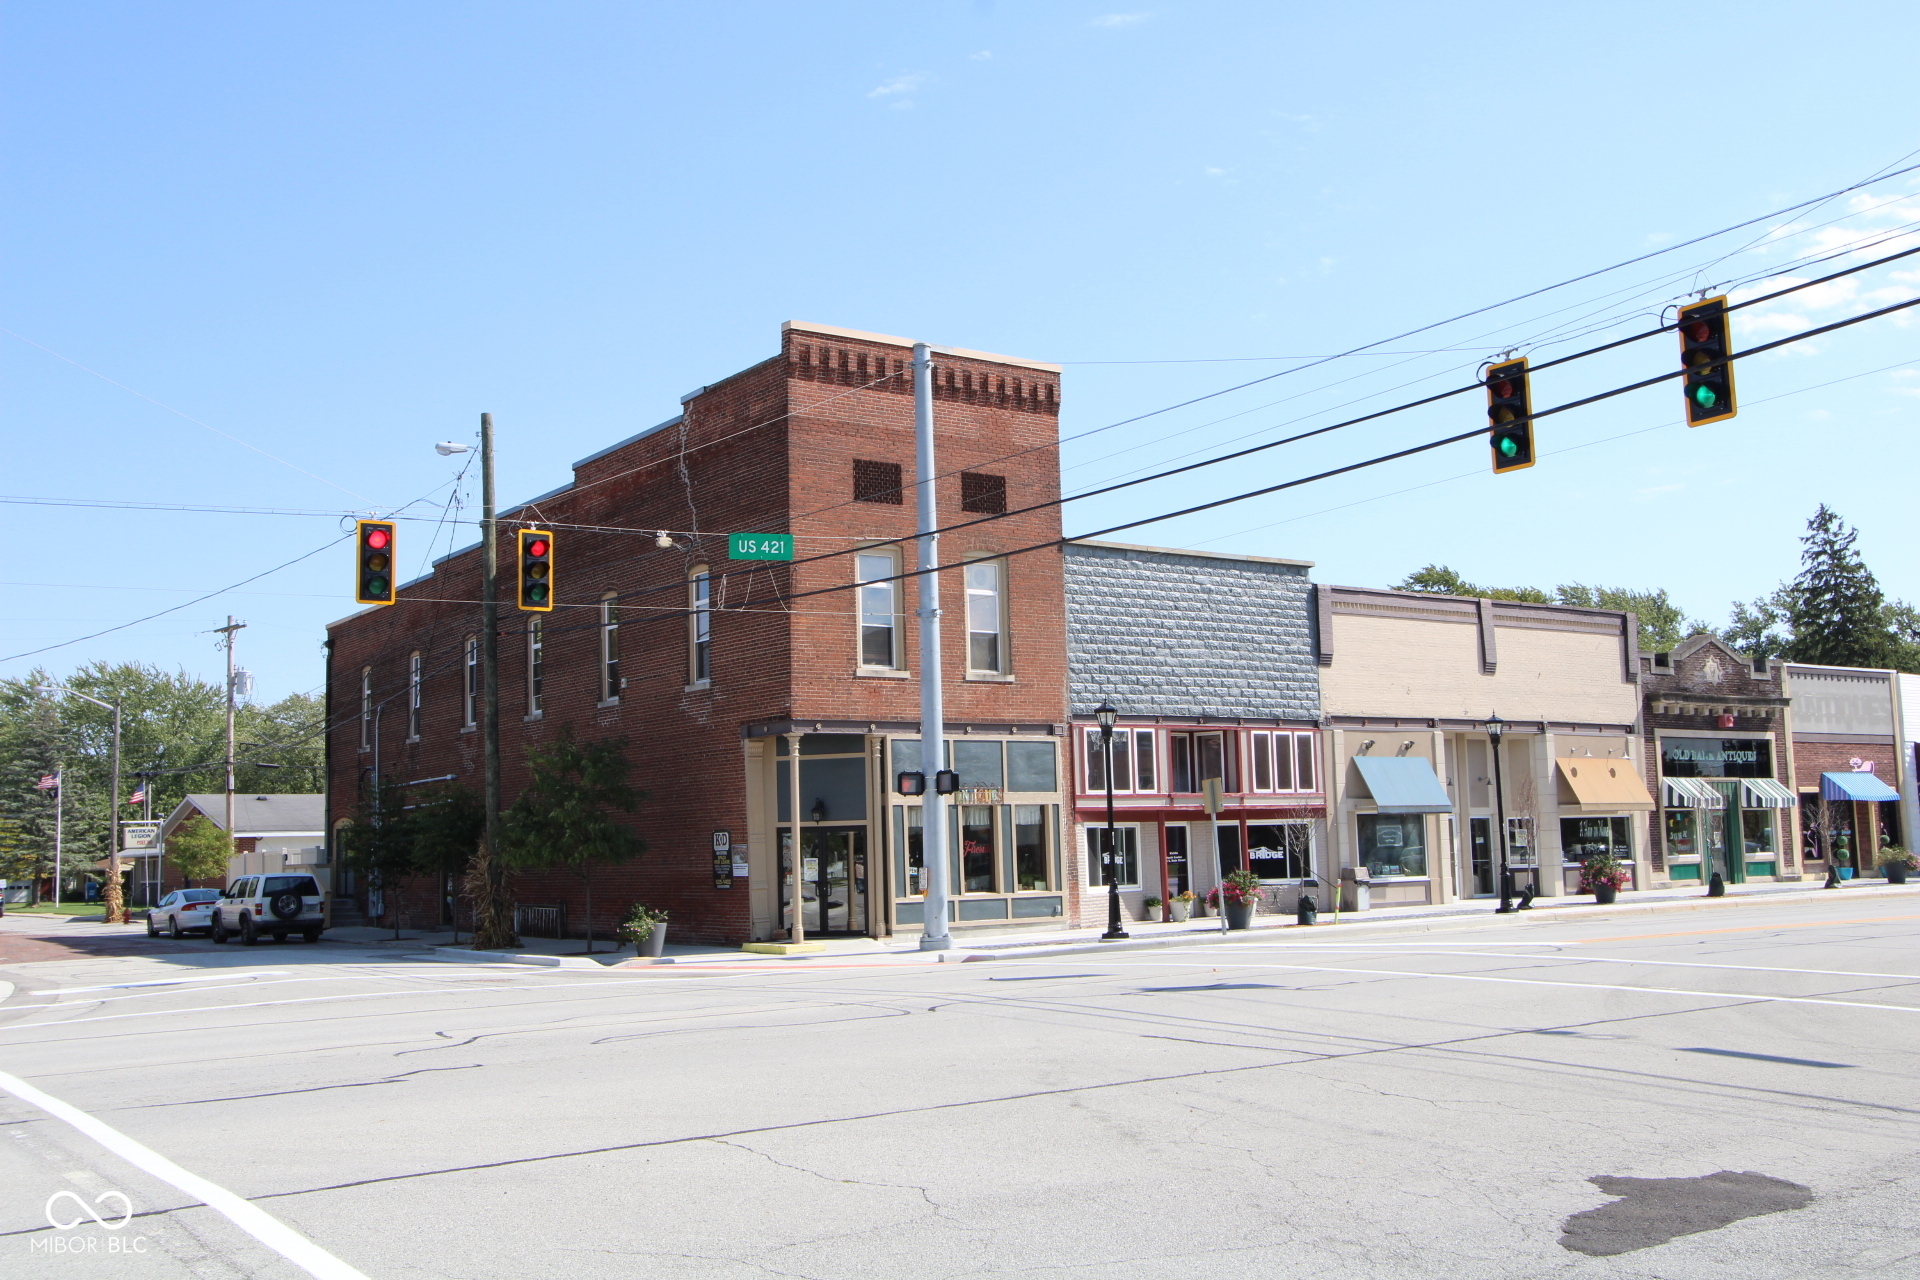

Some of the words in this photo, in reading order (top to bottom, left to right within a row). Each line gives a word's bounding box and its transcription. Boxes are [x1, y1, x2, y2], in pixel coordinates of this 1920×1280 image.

[739, 540, 757, 553] US
[760, 541, 784, 553] 421
[1673, 749, 1691, 760] OLD
[1716, 751, 1757, 764] ANTIQUES
[1670, 831, 1688, 840] JUNK
[1250, 851, 1284, 860] BRIDGE
